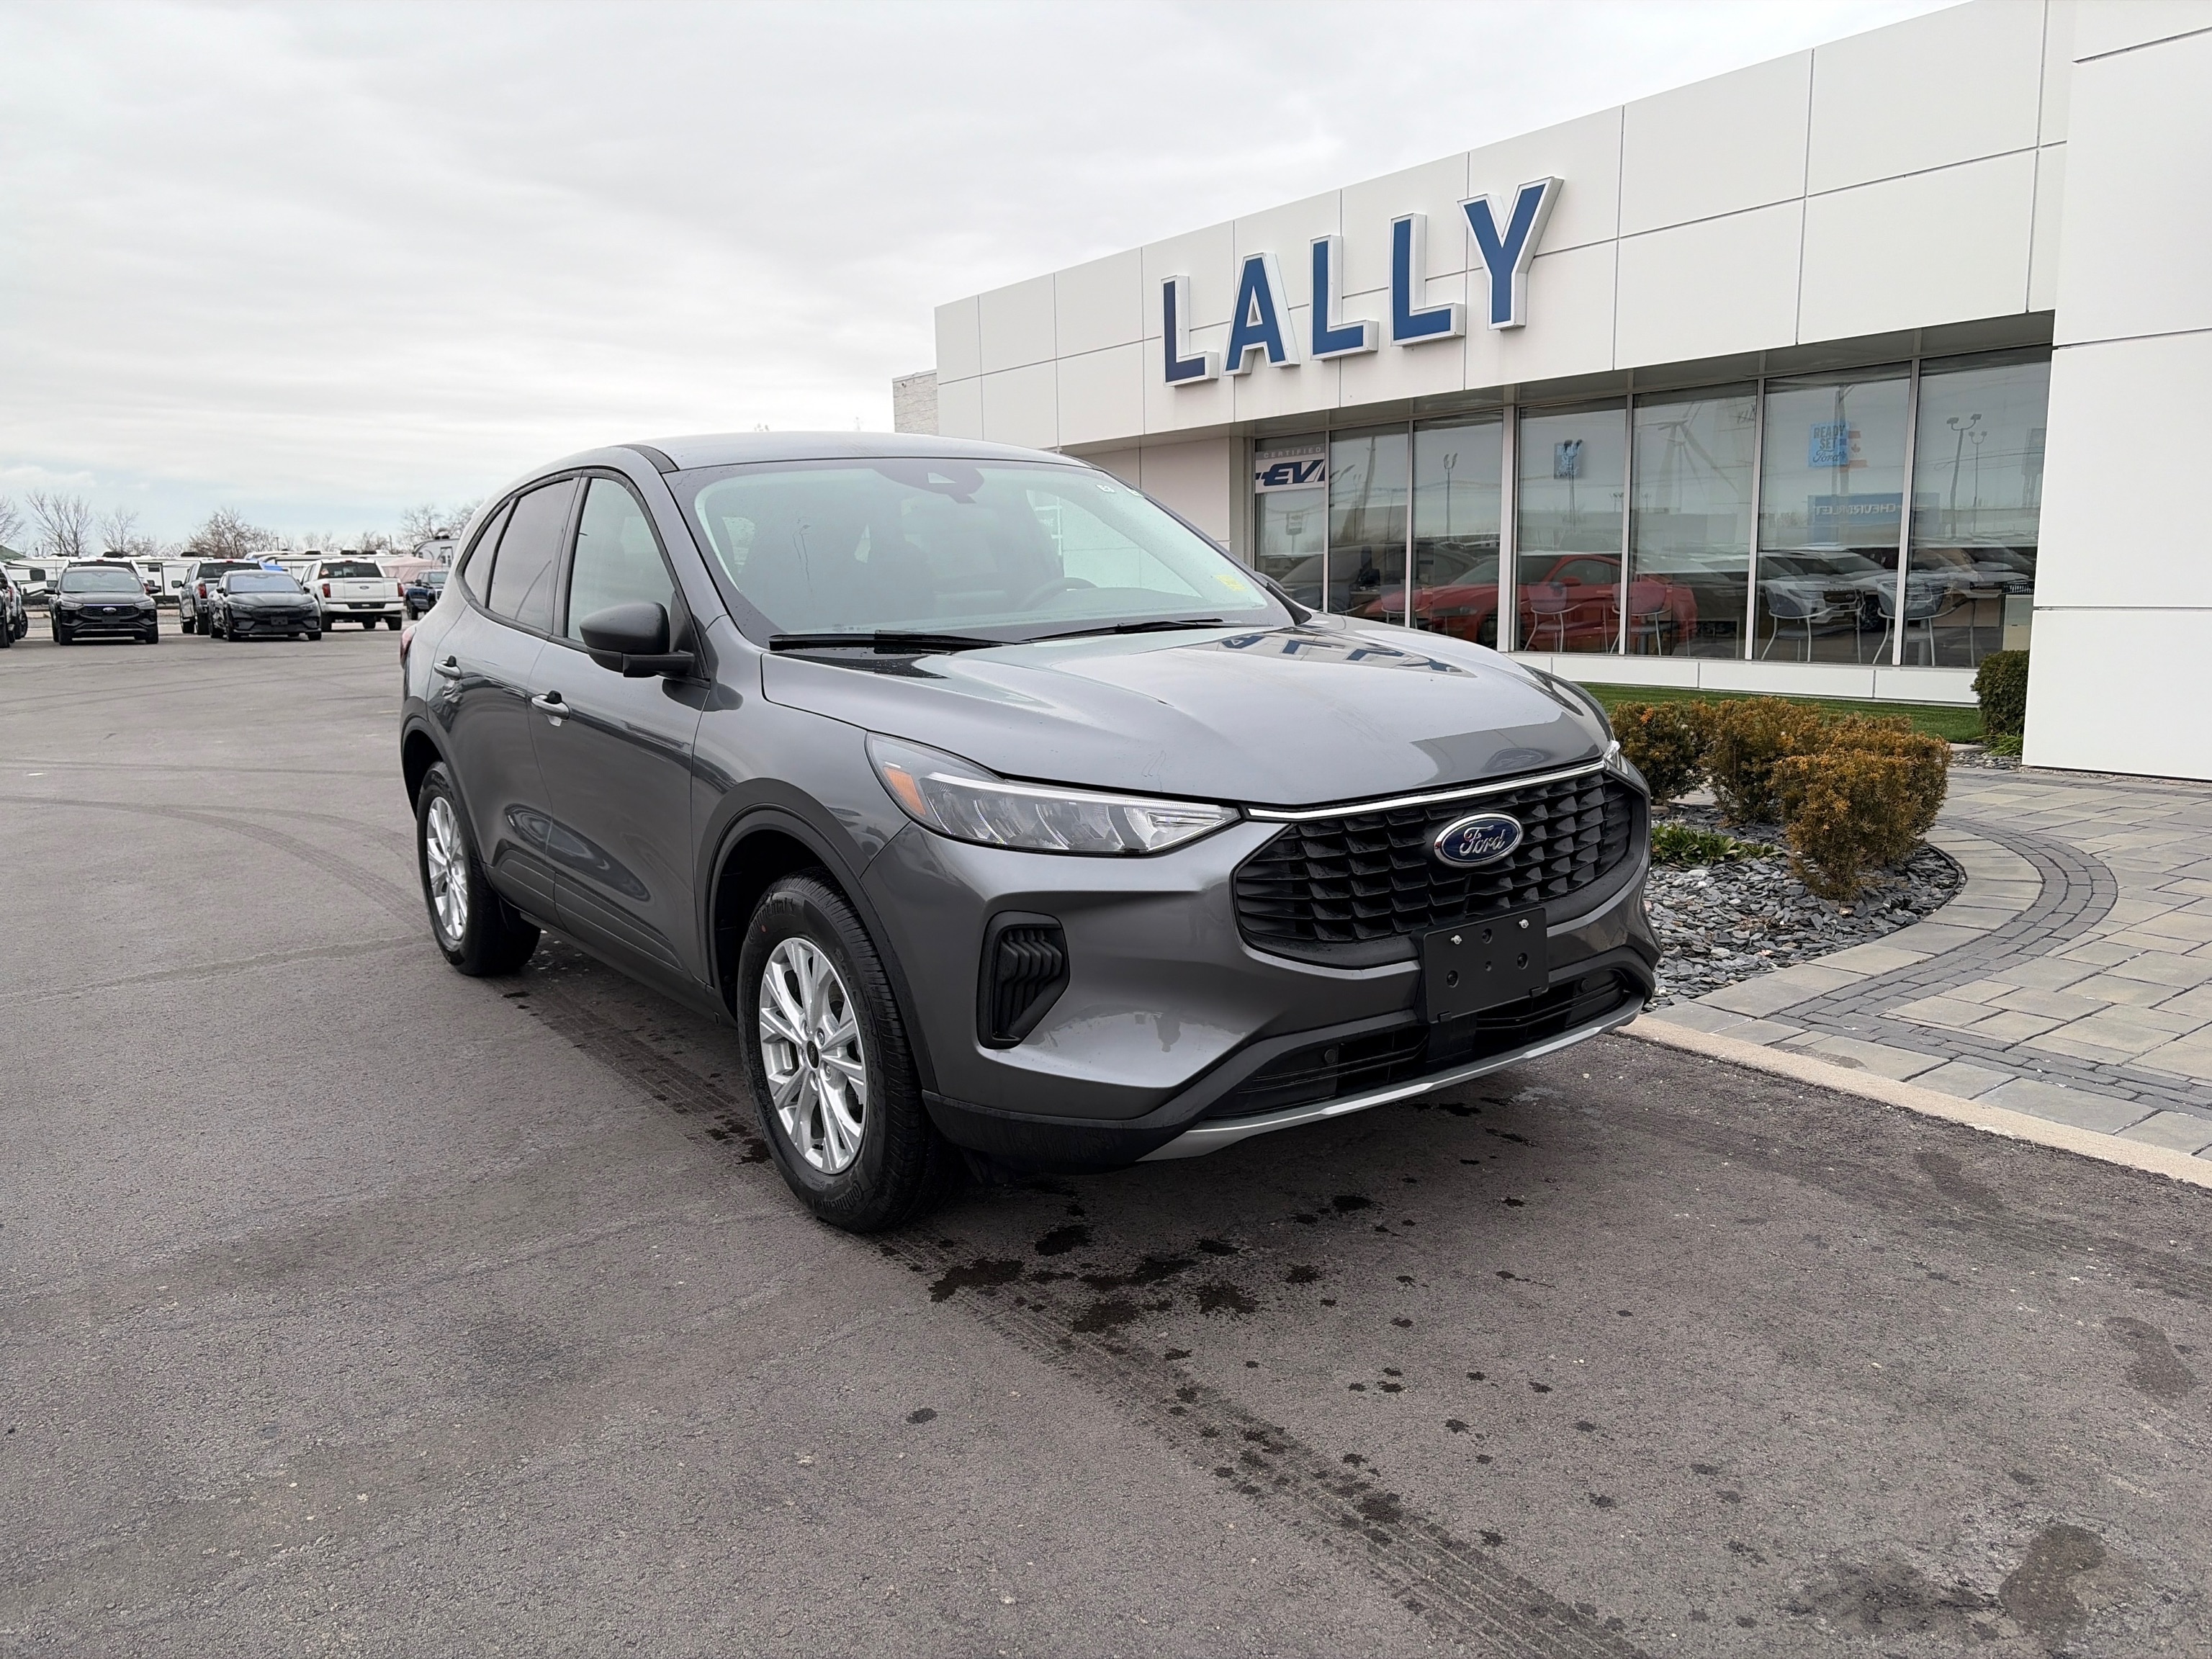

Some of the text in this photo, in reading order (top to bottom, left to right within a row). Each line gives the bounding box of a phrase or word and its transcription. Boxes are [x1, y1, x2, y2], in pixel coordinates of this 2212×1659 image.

[1161, 176, 1563, 387] LALLY
[1813, 424, 1846, 439] READY
[1819, 437, 1838, 449] SET
[1264, 446, 1321, 459] CERTIFIED
[1812, 449, 1845, 463] Ford
[1459, 824, 1506, 857] Ford
